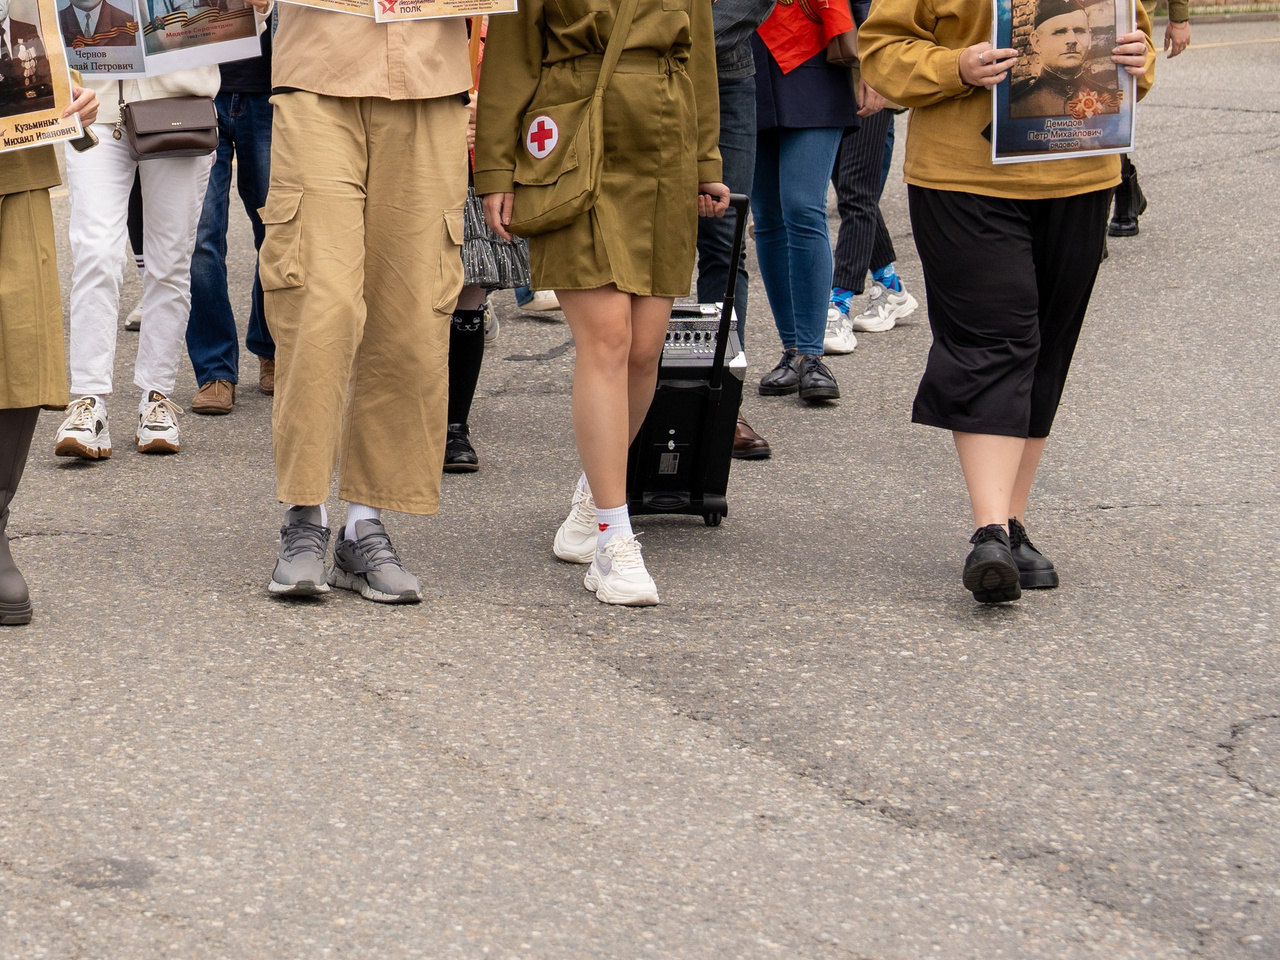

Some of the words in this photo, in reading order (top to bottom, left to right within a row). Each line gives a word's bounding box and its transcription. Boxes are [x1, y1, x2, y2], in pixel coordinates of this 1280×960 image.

[400, 5, 422, 14] ПОЛК
[75, 50, 107, 60] Чернов
[69, 62, 89, 70] олай
[91, 62, 133, 72] Петрович
[15, 118, 60, 133] Кузьминых
[1045, 119, 1083, 128] Демидов
[3, 135, 35, 147] Михаил
[36, 127, 77, 140] Иванович
[1028, 131, 1049, 140] Петр
[1050, 129, 1102, 139] Михайлович
[1050, 141, 1079, 149] рядовой
